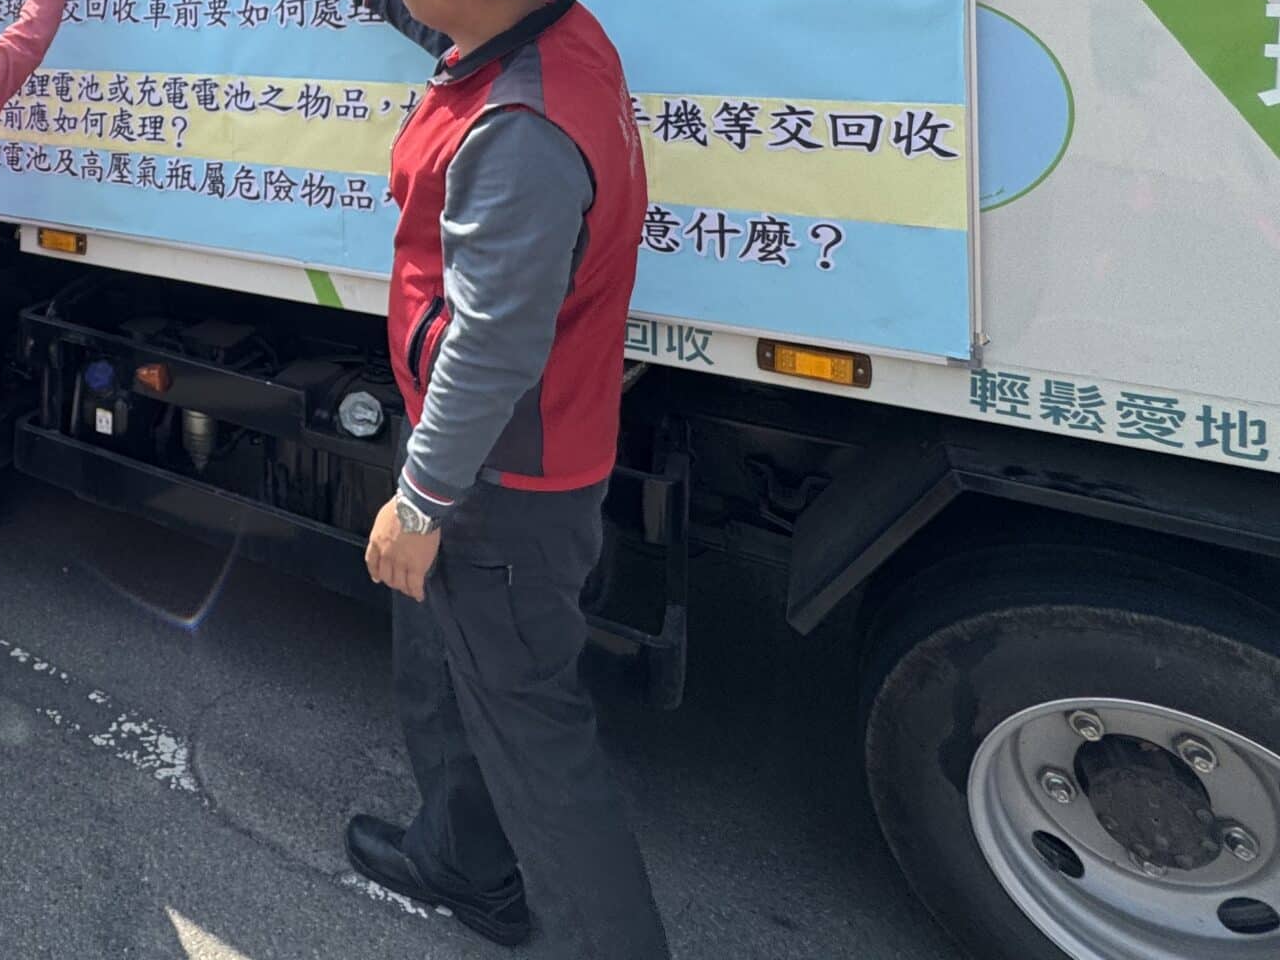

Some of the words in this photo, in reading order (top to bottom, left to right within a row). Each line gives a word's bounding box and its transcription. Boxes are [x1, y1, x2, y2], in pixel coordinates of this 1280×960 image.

[17, 72, 417, 119] 鋰電池或充電電池之物品，
